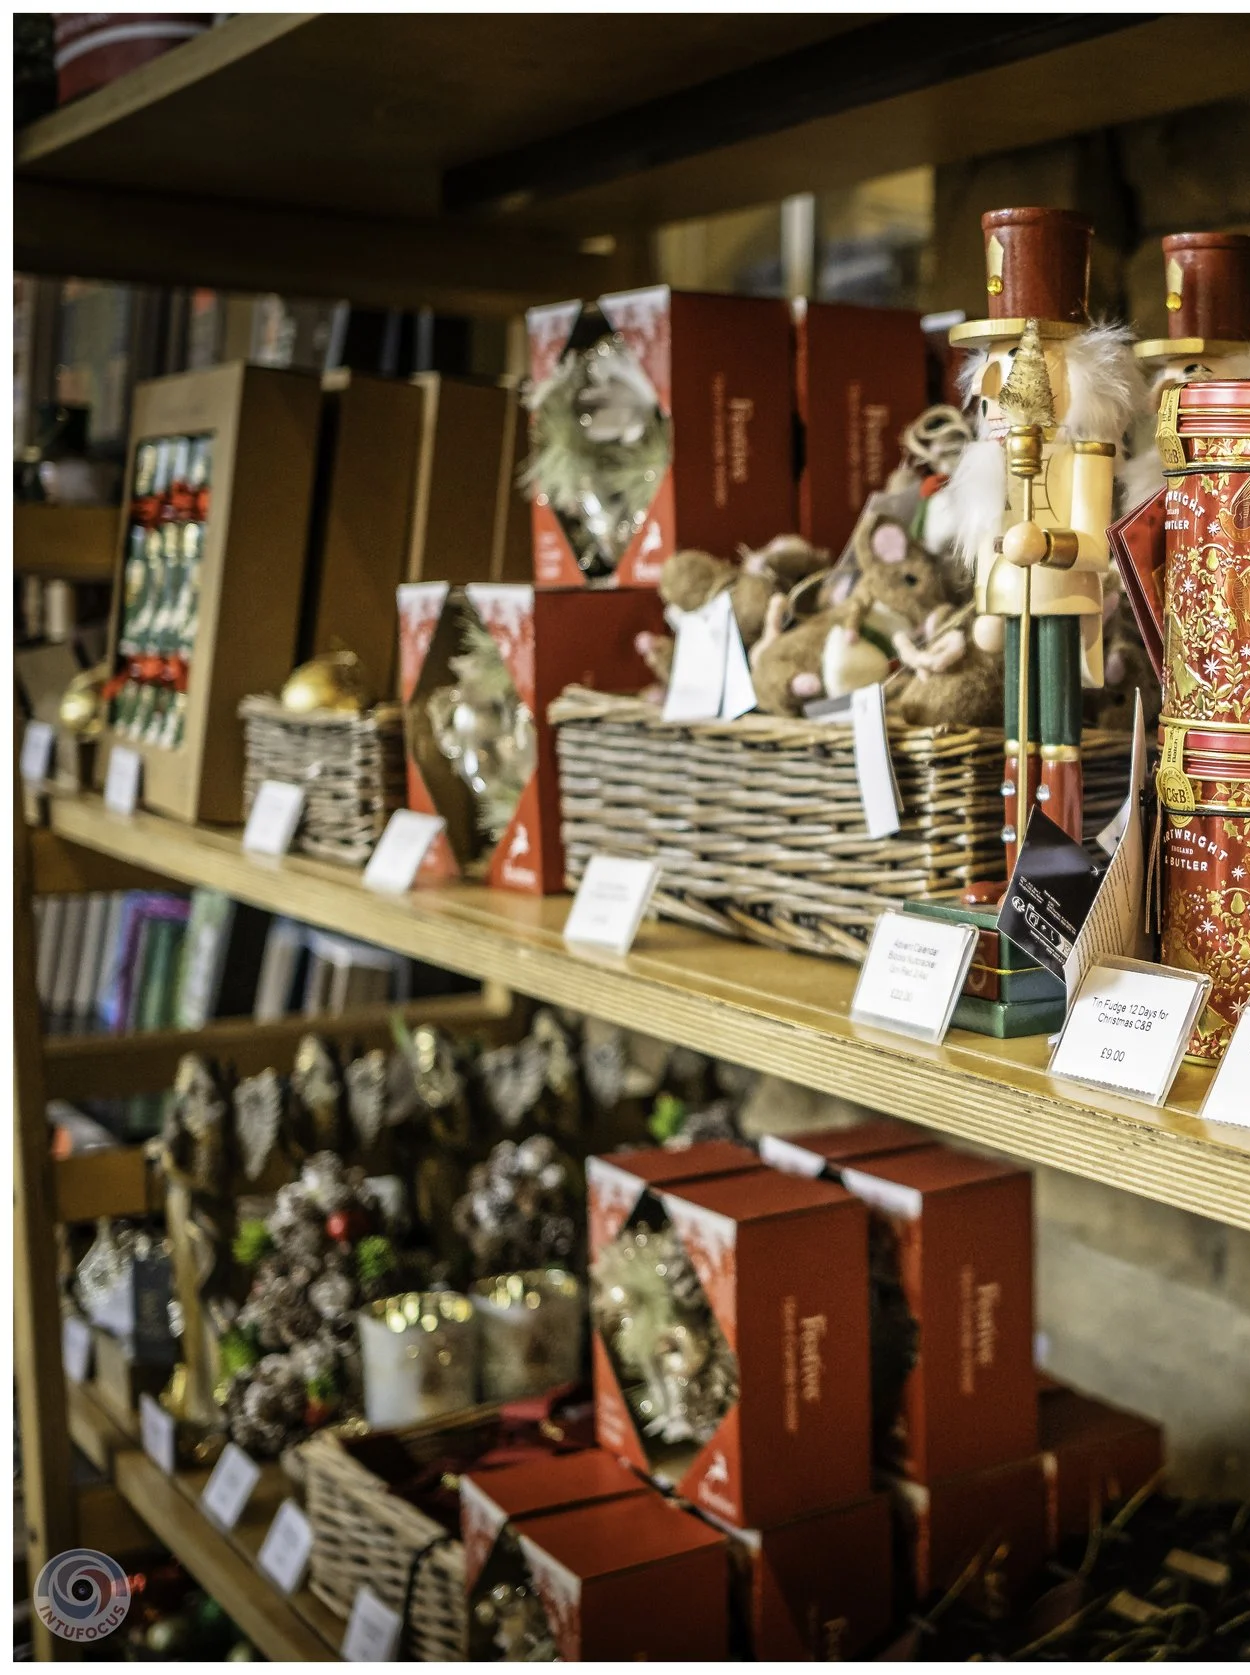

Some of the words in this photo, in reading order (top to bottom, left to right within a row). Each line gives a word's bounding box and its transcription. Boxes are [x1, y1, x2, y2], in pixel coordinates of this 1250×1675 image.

[1166, 787, 1187, 805] C&B
[1169, 856, 1208, 872] BUTLER
[1092, 996, 1103, 1007] Tin
[1104, 999, 1126, 1014] Fudge
[1128, 1004, 1139, 1015] 12
[1138, 1006, 1158, 1020] Days
[1158, 1009, 1169, 1020] for
[1097, 1012, 1134, 1029] Christmas
[1134, 1019, 1153, 1032] C&B
[1100, 1047, 1126, 1062] £9.00
